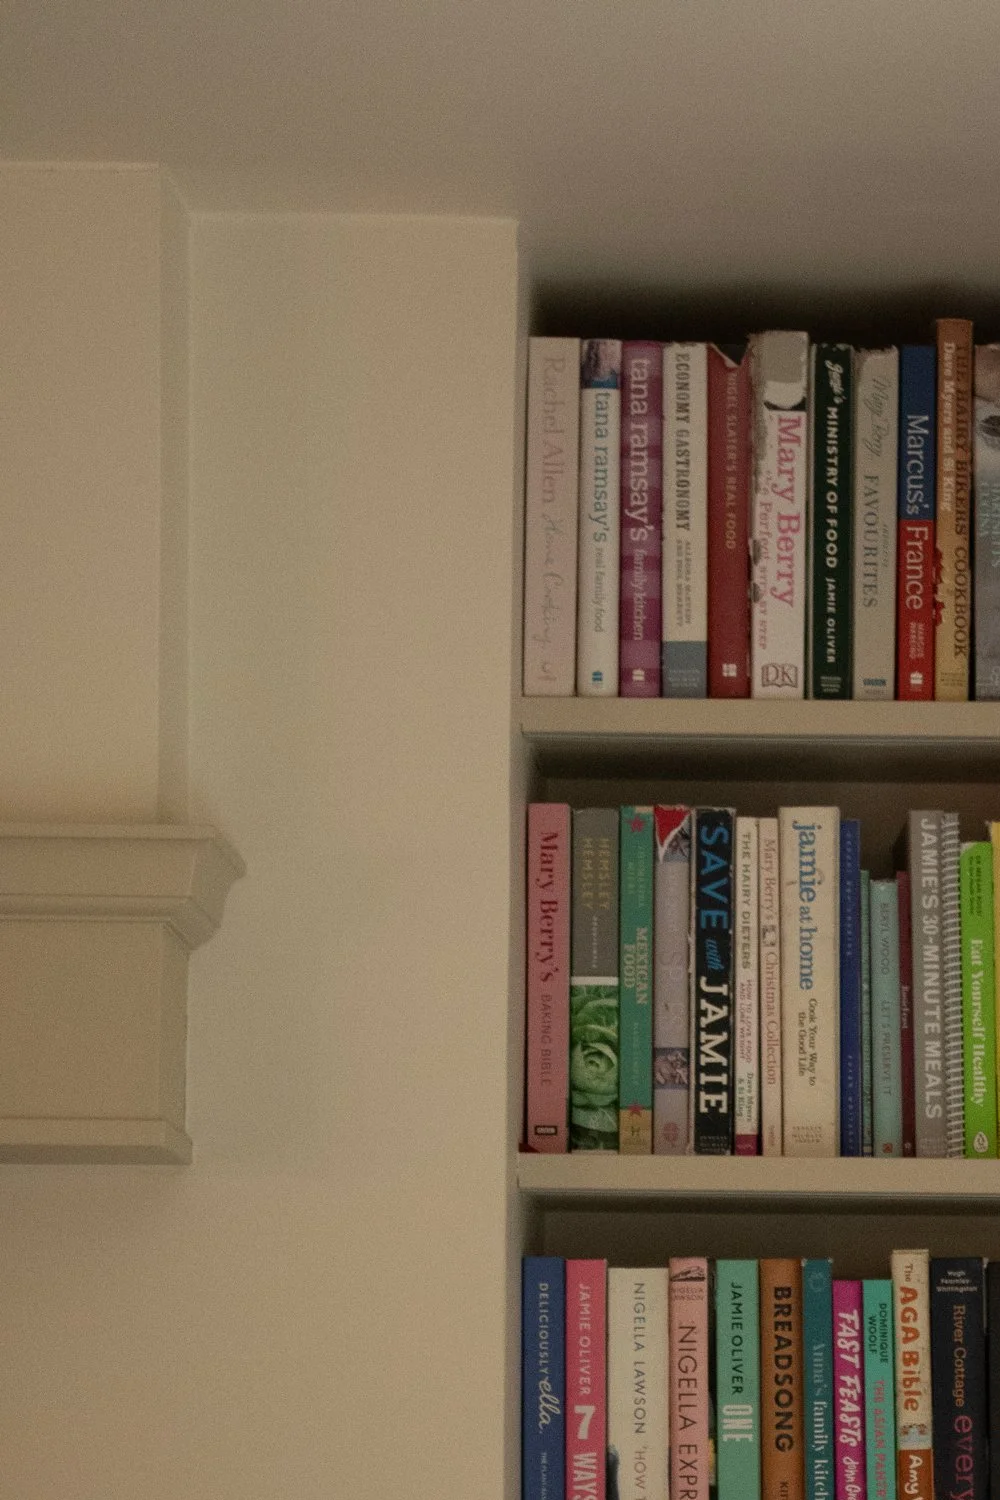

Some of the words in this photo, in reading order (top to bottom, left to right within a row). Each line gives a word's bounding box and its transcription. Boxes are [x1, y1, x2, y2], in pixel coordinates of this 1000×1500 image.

[594, 393, 608, 438] tana
[631, 359, 650, 419] tana
[676, 353, 691, 422] ECONOMY
[771, 416, 801, 502] Mary
[825, 407, 838, 486] MINISTRY
[906, 415, 928, 515] Marcus's
[588, 447, 610, 542] ramsay's
[625, 423, 654, 541] ramsay's
[675, 429, 690, 531] GASTRONOMY
[826, 492, 838, 514] OF
[940, 477, 953, 511] King
[725, 512, 737, 549] FOOD
[772, 513, 801, 607] Berry
[826, 519, 838, 568] FOOD
[863, 475, 879, 607] FAVOURITES
[906, 527, 927, 609] France
[954, 547, 967, 657] COOKBOOK
[762, 665, 798, 686] DK
[535, 832, 558, 890] Mary
[700, 824, 728, 929] SAVE
[792, 821, 822, 902] jamie
[920, 819, 939, 909] JAMIE'S
[536, 899, 559, 982] Berry's
[799, 907, 812, 921] at
[623, 944, 635, 988] FOOD
[635, 927, 648, 1005] MEXICAN
[704, 939, 724, 972] with
[765, 951, 777, 1018] Christmas
[799, 926, 818, 990] home
[808, 999, 818, 1022] Cook
[808, 1025, 818, 1048] Your
[699, 975, 728, 1114] JAMIE
[765, 1021, 778, 1085] Collection
[807, 1051, 818, 1073] Way
[970, 1043, 986, 1106] Healthy
[808, 1075, 817, 1087] to
[923, 1040, 941, 1118] MEALS
[904, 1264, 913, 1282] The
[538, 1283, 549, 1381] DELICIOUSLY
[579, 1283, 590, 1329] JAMIE
[634, 1283, 645, 1351] NIGELLA
[730, 1282, 742, 1330] JAMIE
[868, 1315, 877, 1354] WOOLF
[878, 1303, 888, 1363] DOMINIQUE
[899, 1286, 918, 1344] AGA
[953, 1304, 965, 1343] River
[579, 1336, 590, 1395] OLIVER
[731, 1335, 743, 1394] OLIVER
[837, 1309, 860, 1367] FAST
[634, 1361, 645, 1434] LAWSON
[679, 1325, 697, 1431] NIGELLA
[773, 1286, 793, 1452] BREADSONG
[902, 1350, 921, 1411] Bible
[952, 1347, 966, 1407] Cottage
[723, 1404, 753, 1441] ONE
[811, 1400, 828, 1452] family
[838, 1375, 859, 1447] FEASTS
[843, 1457, 859, 1482] John
[905, 1454, 923, 1494] Amy
